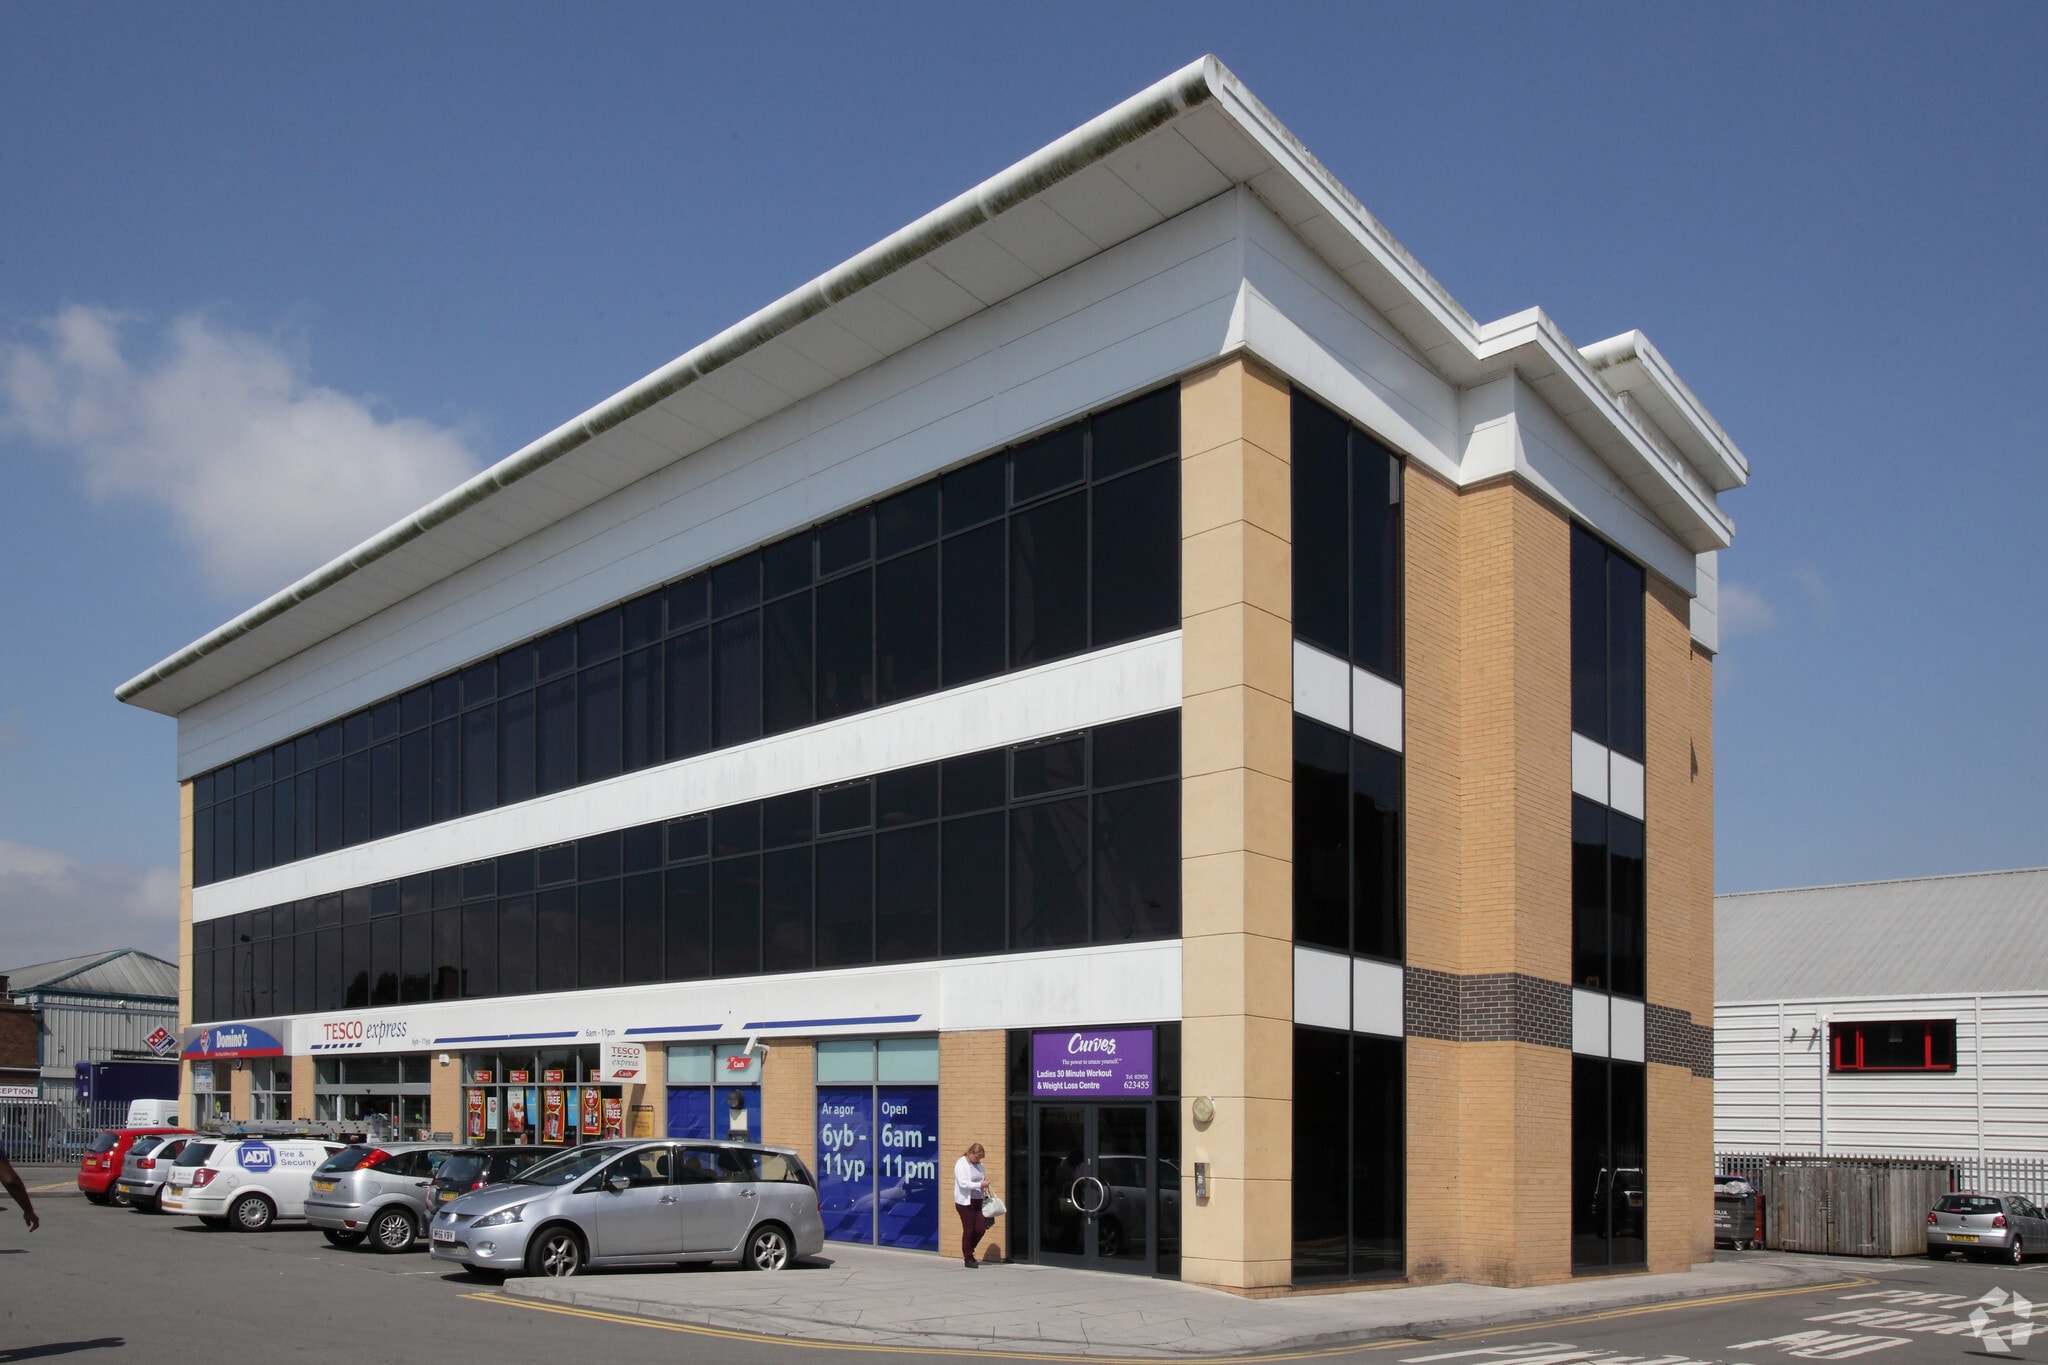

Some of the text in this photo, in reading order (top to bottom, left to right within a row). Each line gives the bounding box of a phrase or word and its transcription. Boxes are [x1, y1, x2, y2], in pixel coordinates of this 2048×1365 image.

[216, 1029, 248, 1048] Domino's
[324, 1020, 407, 1045] TESCO express
[611, 1046, 640, 1055] TESCO
[611, 1059, 639, 1067] express
[1037, 1069, 1112, 1078] Ladies 30 Minute Workout
[1043, 1082, 1063, 1091] Weight
[1064, 1081, 1078, 1089] Loss
[1079, 1081, 1100, 1089] Centre
[1123, 1081, 1149, 1089] 623455
[547, 1096, 560, 1105] FREE
[606, 1109, 621, 1119] FREE
[822, 1103, 855, 1117] Ar agor
[882, 1102, 908, 1117] Open
[822, 1123, 854, 1152] 6yb
[882, 1123, 922, 1148] 6am
[244, 1150, 270, 1164] ADT
[281, 1158, 317, 1167] Security
[823, 1152, 865, 1182] 11yp
[883, 1154, 935, 1184] 11pm
